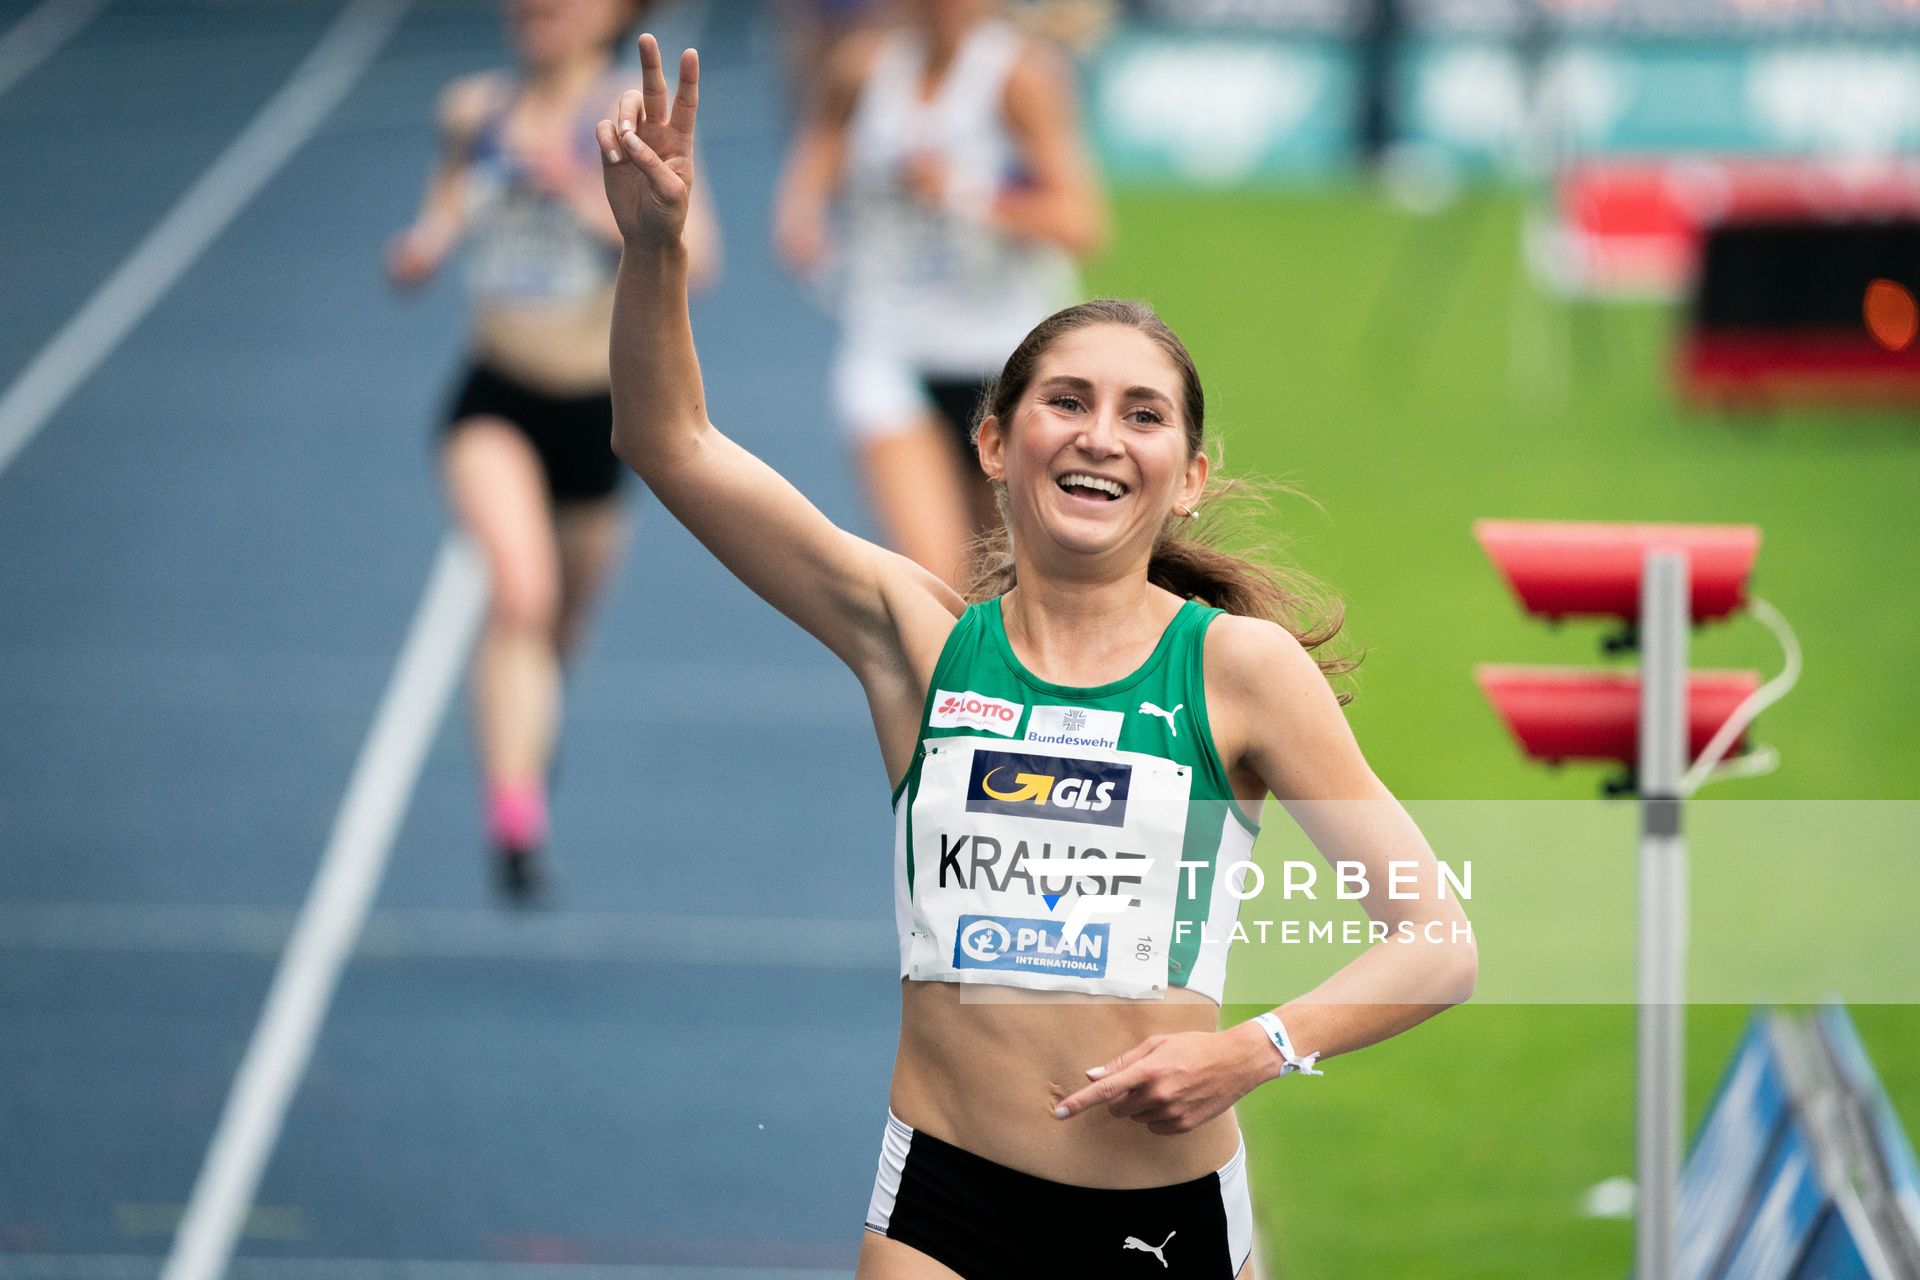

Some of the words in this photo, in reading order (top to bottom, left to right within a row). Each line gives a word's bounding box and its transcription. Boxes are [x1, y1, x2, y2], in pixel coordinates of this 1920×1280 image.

[960, 698, 1014, 721] LOTTO
[1028, 731, 1115, 748] Bundeswehr
[1051, 778, 1115, 811] GLS
[939, 834, 1146, 907] KRAUSE
[1016, 927, 1102, 959] PLAN
[1135, 936, 1152, 962] 180
[1015, 956, 1099, 972] INTERNATIONAL
